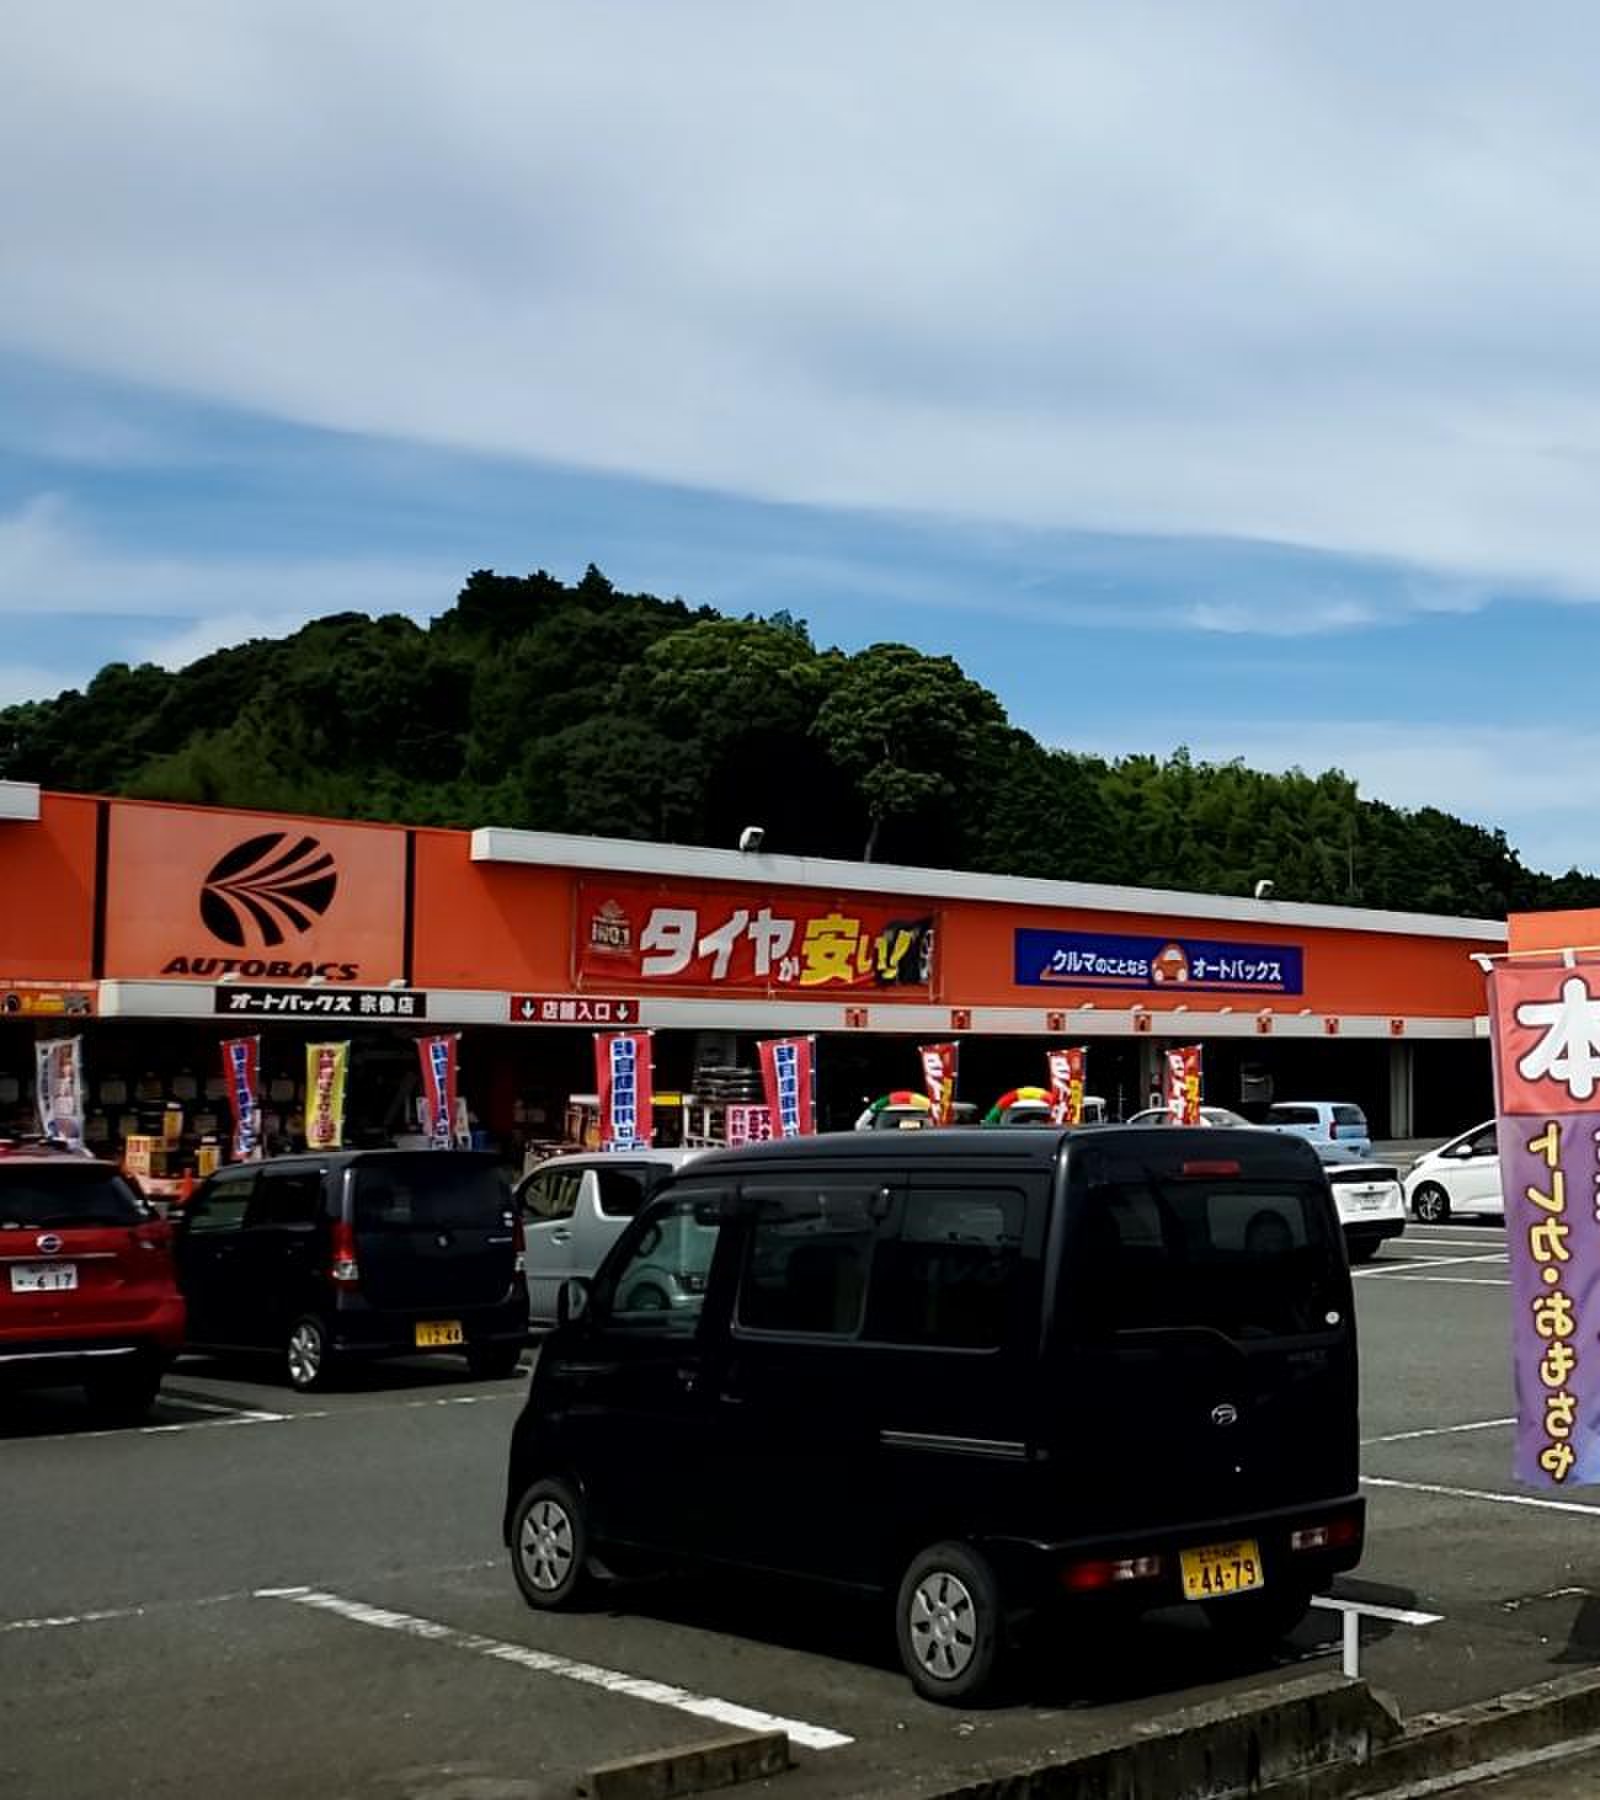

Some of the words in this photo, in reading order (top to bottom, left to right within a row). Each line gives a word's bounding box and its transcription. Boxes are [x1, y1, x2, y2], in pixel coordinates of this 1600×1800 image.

[161, 956, 360, 981] AUTOBACS
[1052, 949, 1148, 976] クルマのことなら
[1193, 957, 1282, 981] オートバックス
[229, 992, 353, 1013] オートバックス
